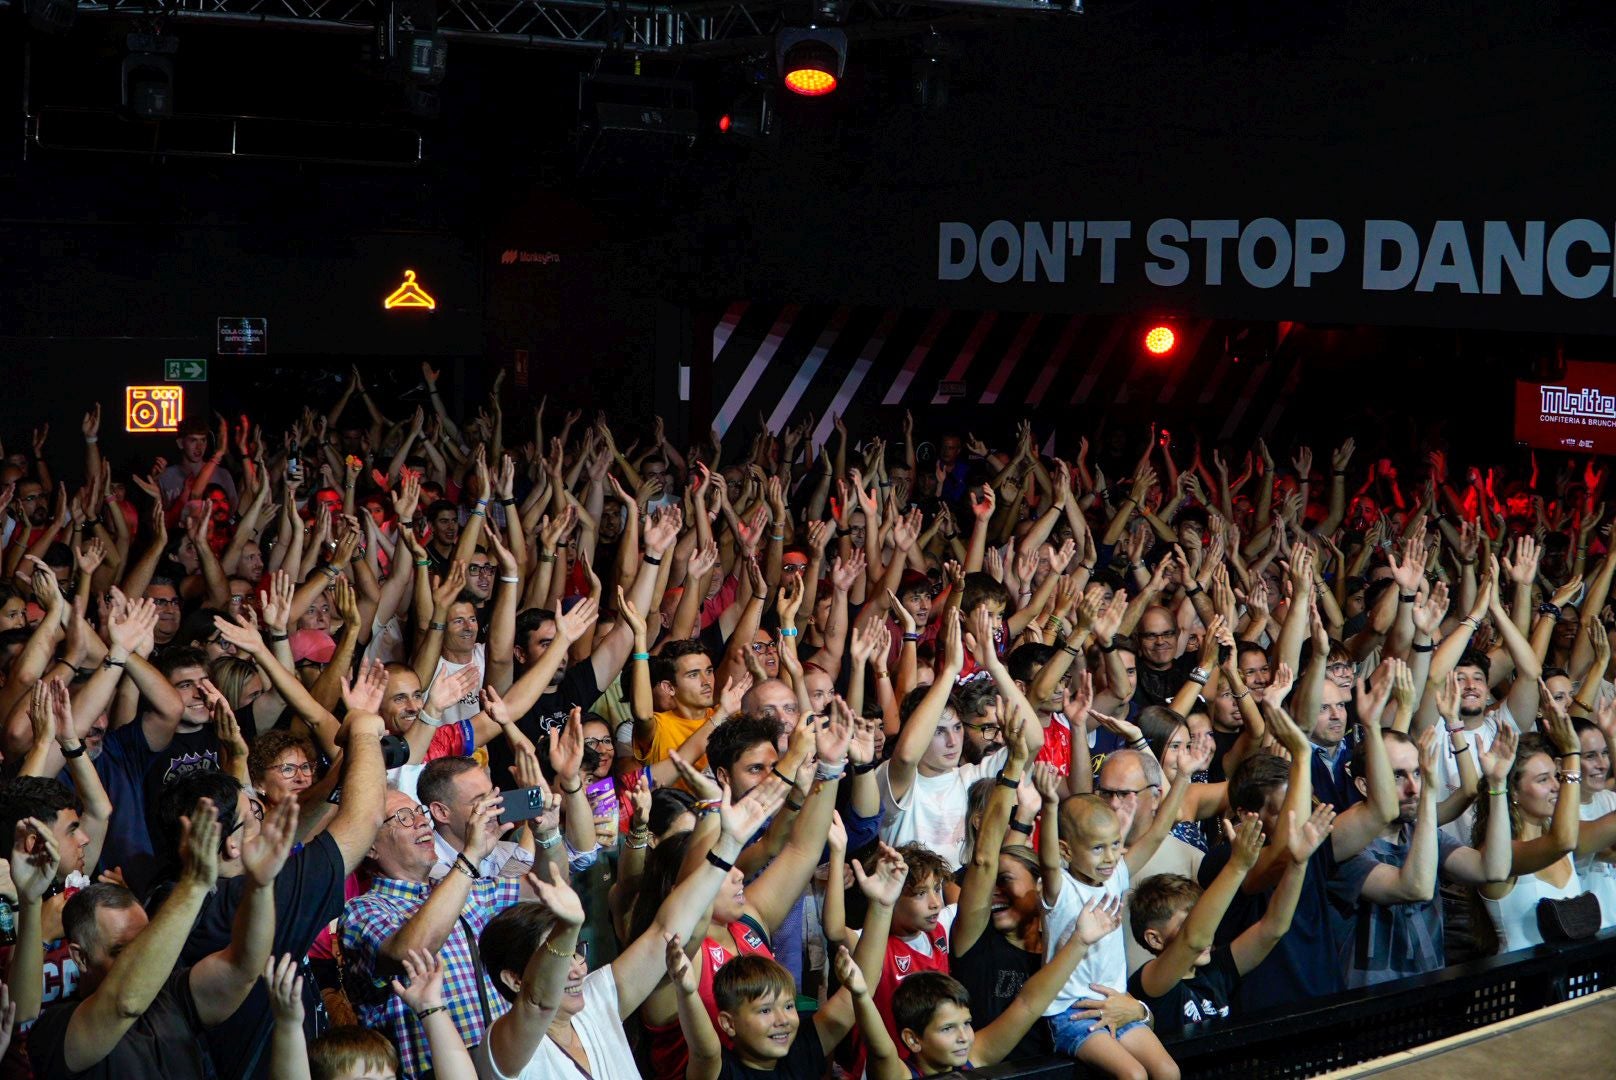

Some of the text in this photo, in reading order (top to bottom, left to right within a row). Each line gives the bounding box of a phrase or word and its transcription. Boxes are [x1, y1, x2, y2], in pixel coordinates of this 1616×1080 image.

[938, 218, 1616, 299] DON'T STOP DANC
[1539, 415, 1580, 424] CONFITERIA
[1588, 418, 1616, 427] BRUNCH
